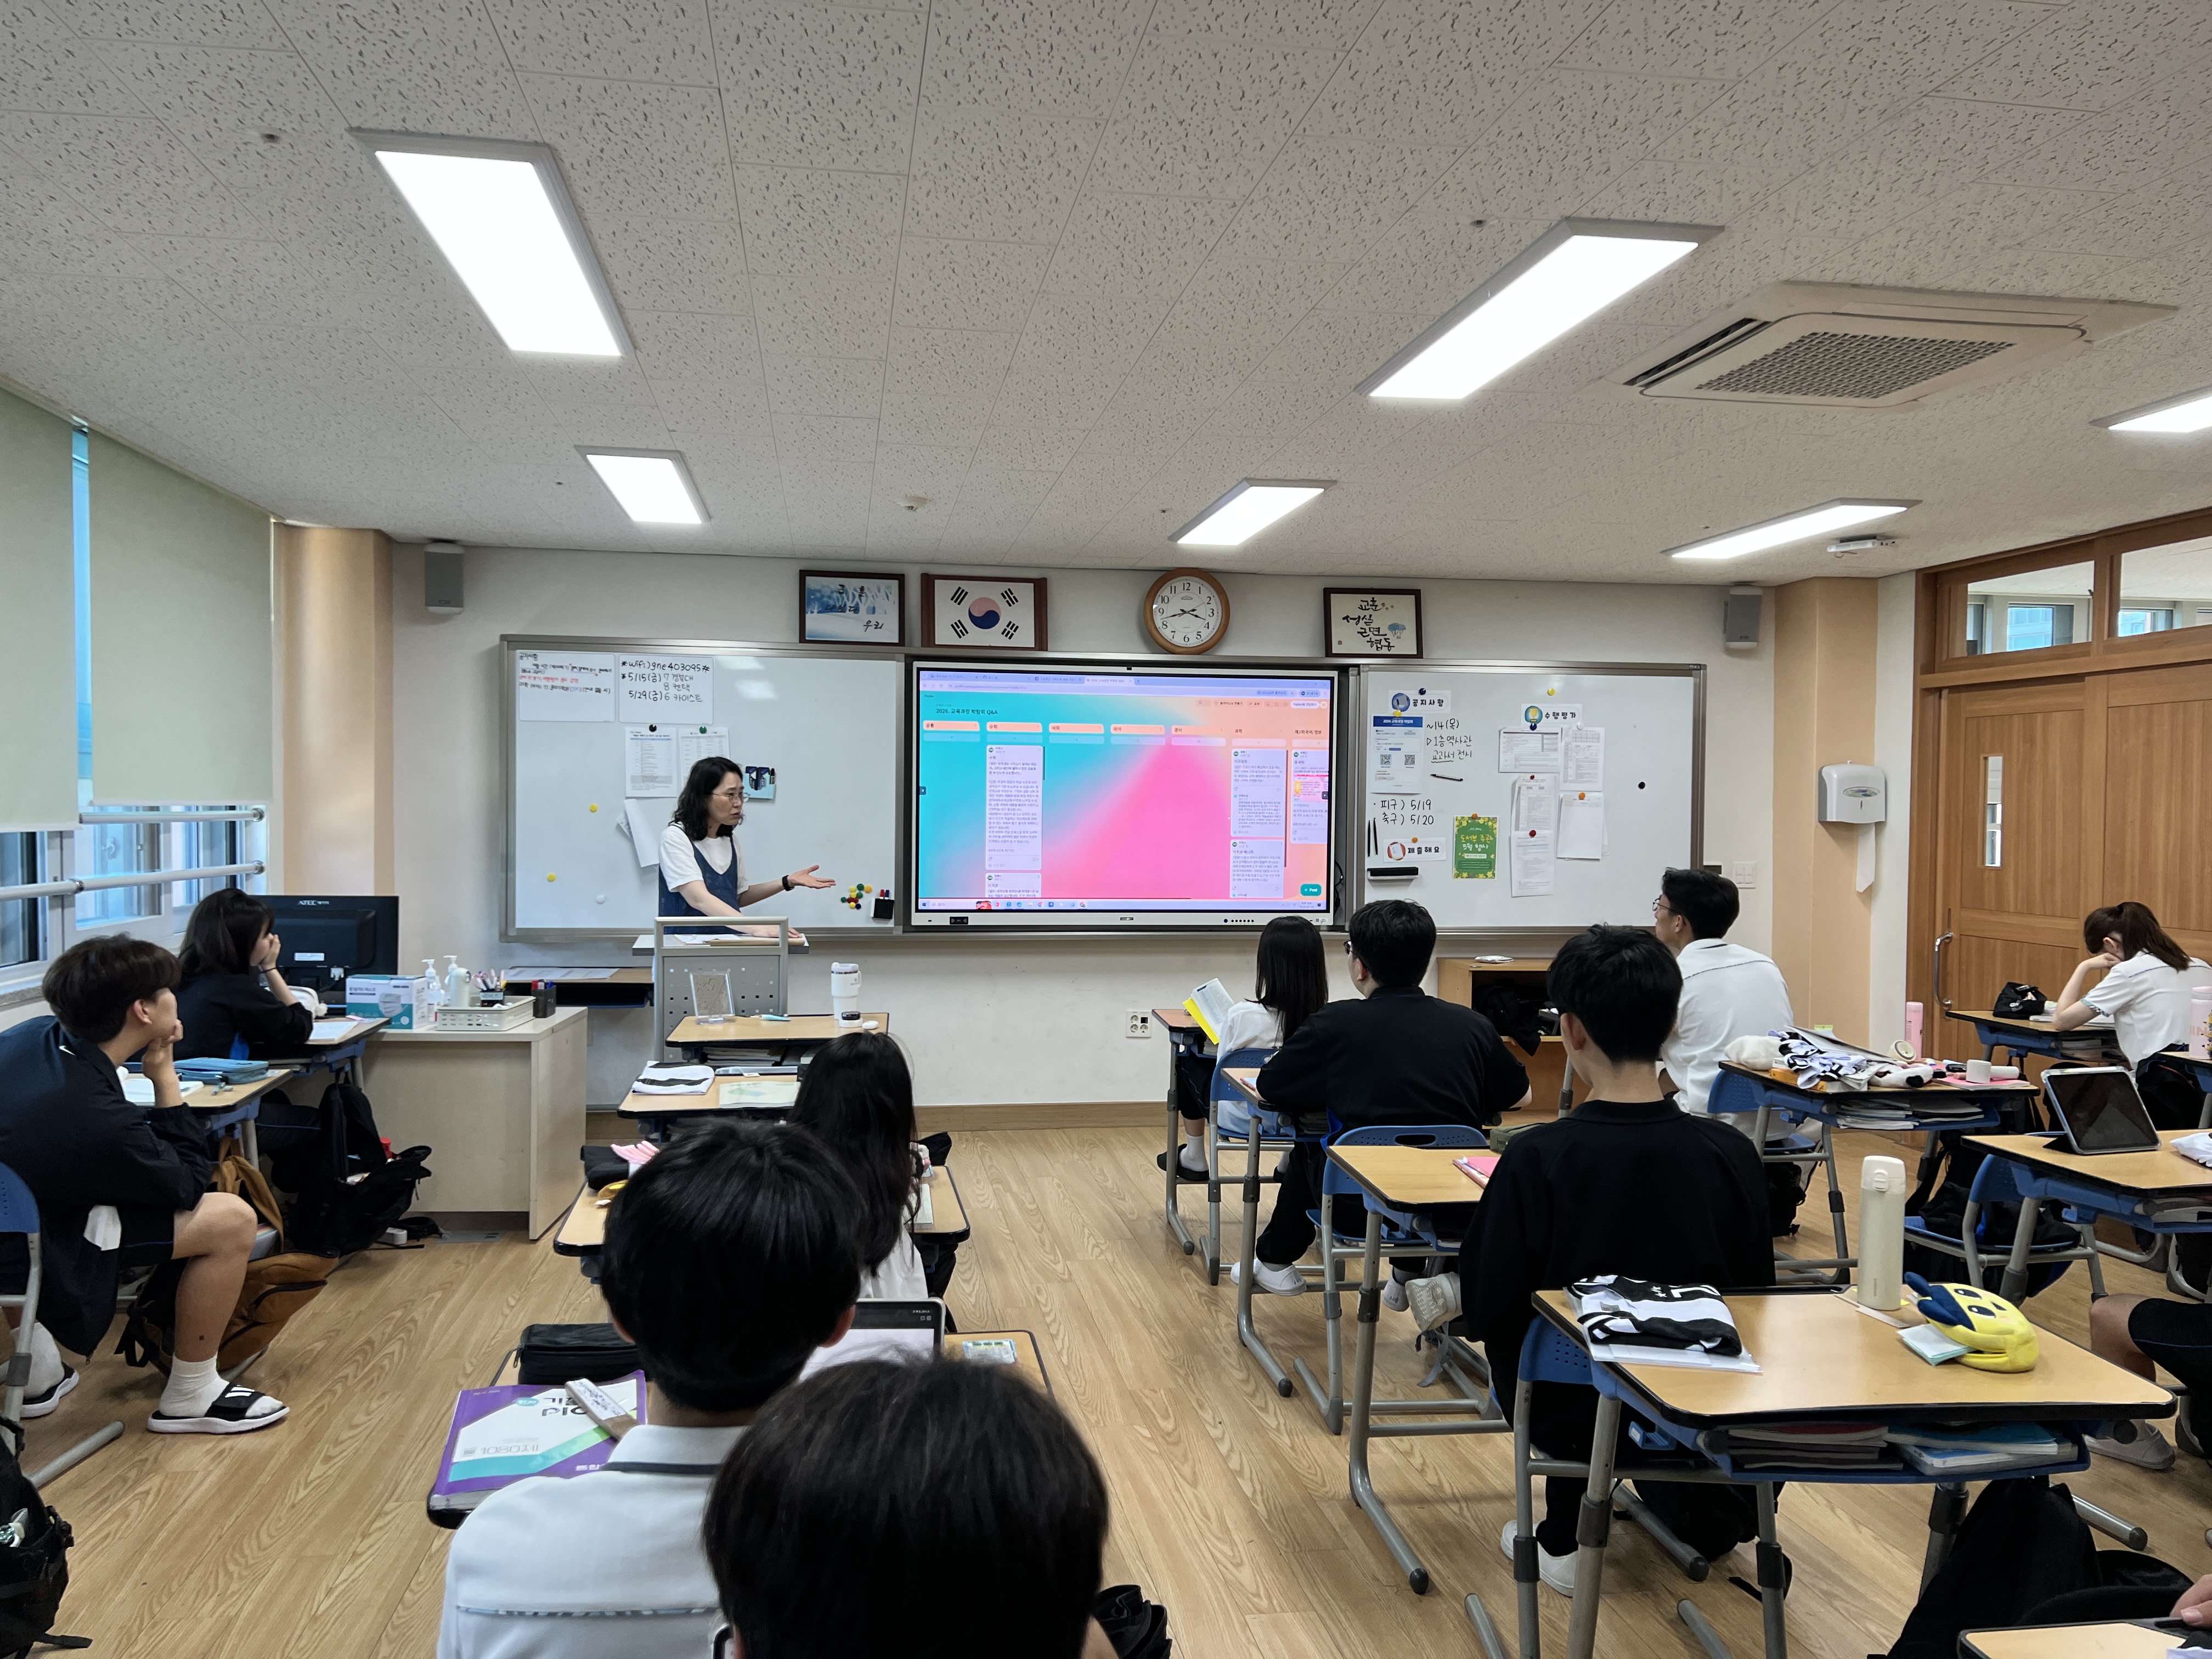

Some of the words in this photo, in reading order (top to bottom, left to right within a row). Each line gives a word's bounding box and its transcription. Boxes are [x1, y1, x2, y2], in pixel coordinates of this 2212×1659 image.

[1170, 585, 1176, 594] 11
[1183, 582, 1190, 591] 12
[1199, 586, 1201, 594] 1
[1161, 595, 1169, 604] 10
[1206, 596, 1211, 605] 2
[1358, 597, 1381, 612] 교훈
[1158, 608, 1164, 616] 9
[1208, 608, 1215, 617] 3
[1161, 620, 1168, 629] 8
[1342, 614, 1374, 626] 성실
[863, 620, 884, 632] 우리
[1204, 622, 1210, 630] 4
[1171, 631, 1176, 639] 7
[1195, 631, 1201, 640] 5
[1357, 627, 1387, 637] 근면
[1183, 634, 1189, 642] 6
[1367, 637, 1395, 652] 협동
[672, 673, 694, 682] 경북대
[663, 682, 670, 691] 8
[664, 692, 670, 701] 6
[673, 694, 703, 702] 카이스트
[1412, 699, 1444, 707] 공지사항
[1544, 712, 1576, 720] 수행평가
[1431, 750, 1455, 760] 교과서
[1456, 749, 1472, 760] 전시
[1410, 799, 1431, 810] 5/19
[1410, 814, 1434, 825] 5/20
